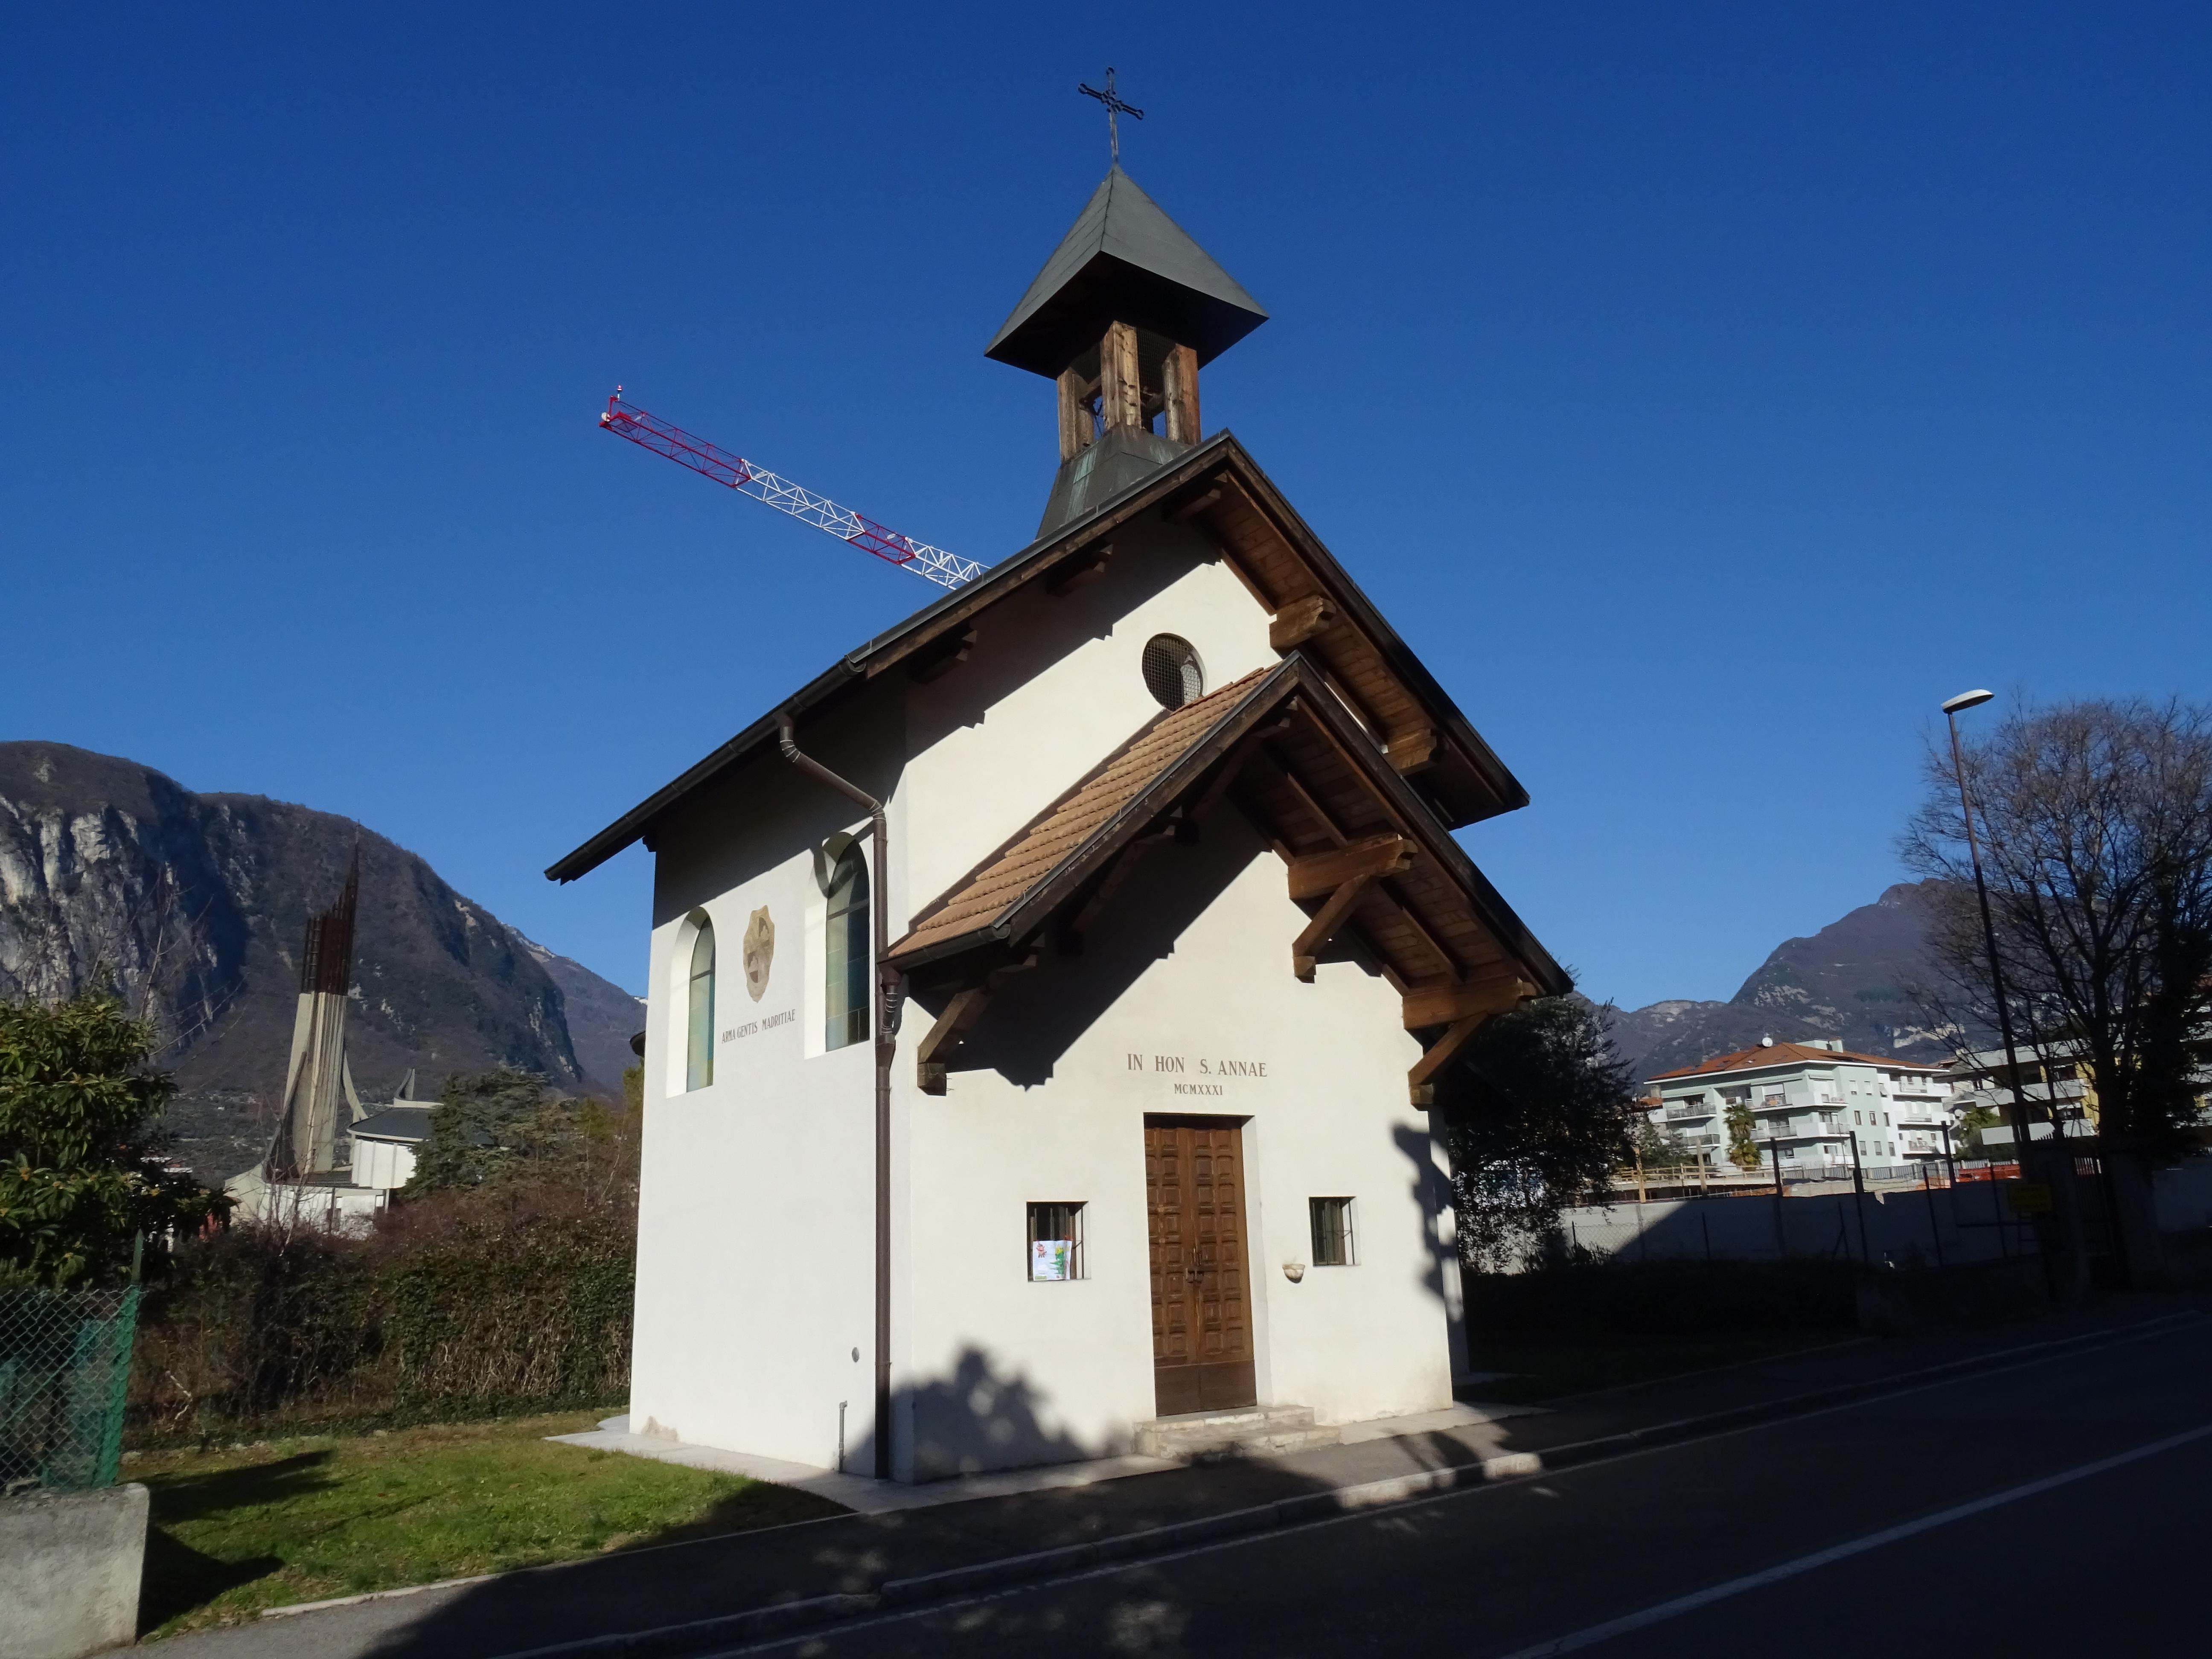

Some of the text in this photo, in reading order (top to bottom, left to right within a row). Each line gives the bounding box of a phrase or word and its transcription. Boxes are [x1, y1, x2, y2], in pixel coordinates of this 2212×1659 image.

[737, 1021, 758, 1038] GENTIS
[762, 1009, 796, 1031] MADRITIAE
[1127, 1054, 1267, 1077] IN HON S. ANNAE
[1174, 1083, 1222, 1095] MCMXXXI
